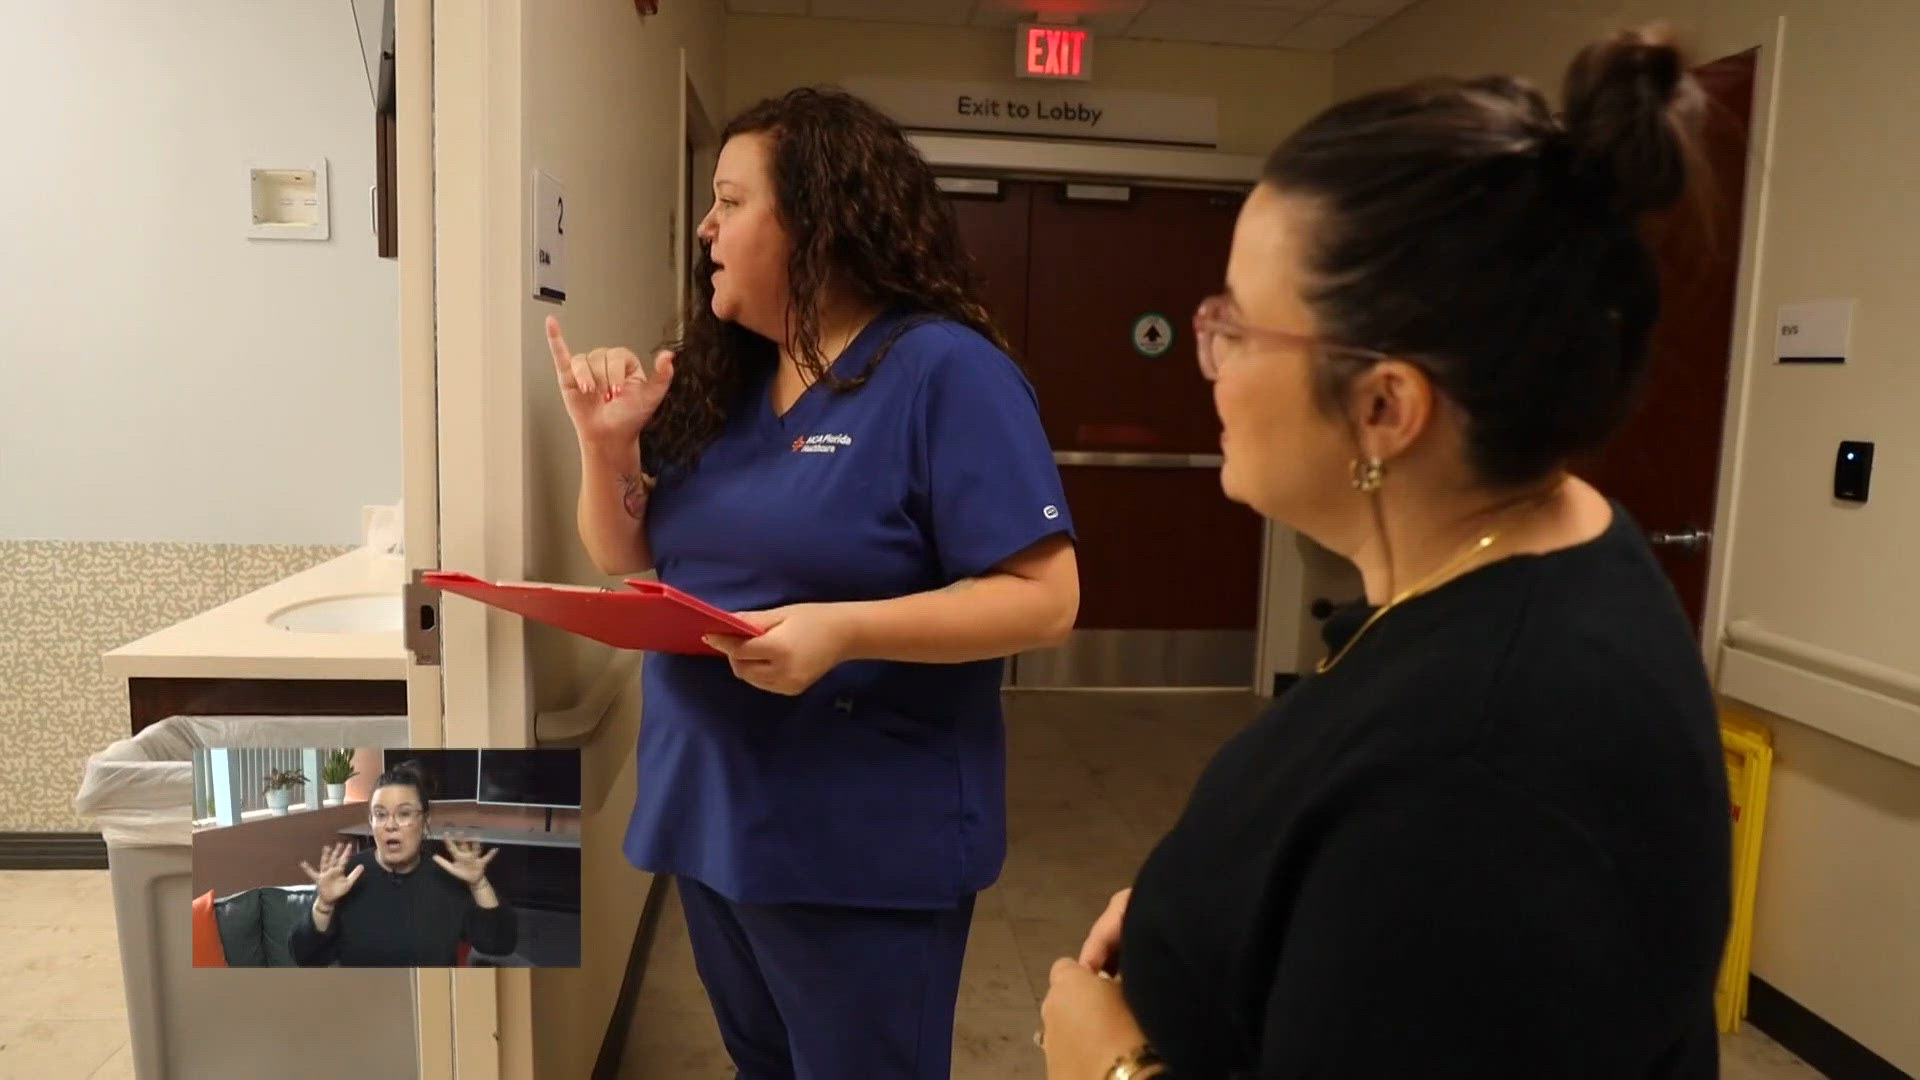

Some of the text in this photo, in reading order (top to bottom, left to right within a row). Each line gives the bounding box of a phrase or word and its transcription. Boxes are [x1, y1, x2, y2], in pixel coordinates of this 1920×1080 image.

[1027, 28, 1087, 75] EXIT
[957, 95, 1103, 127] Exit to Lobby
[557, 196, 564, 235] 2
[822, 432, 852, 446] Florida
